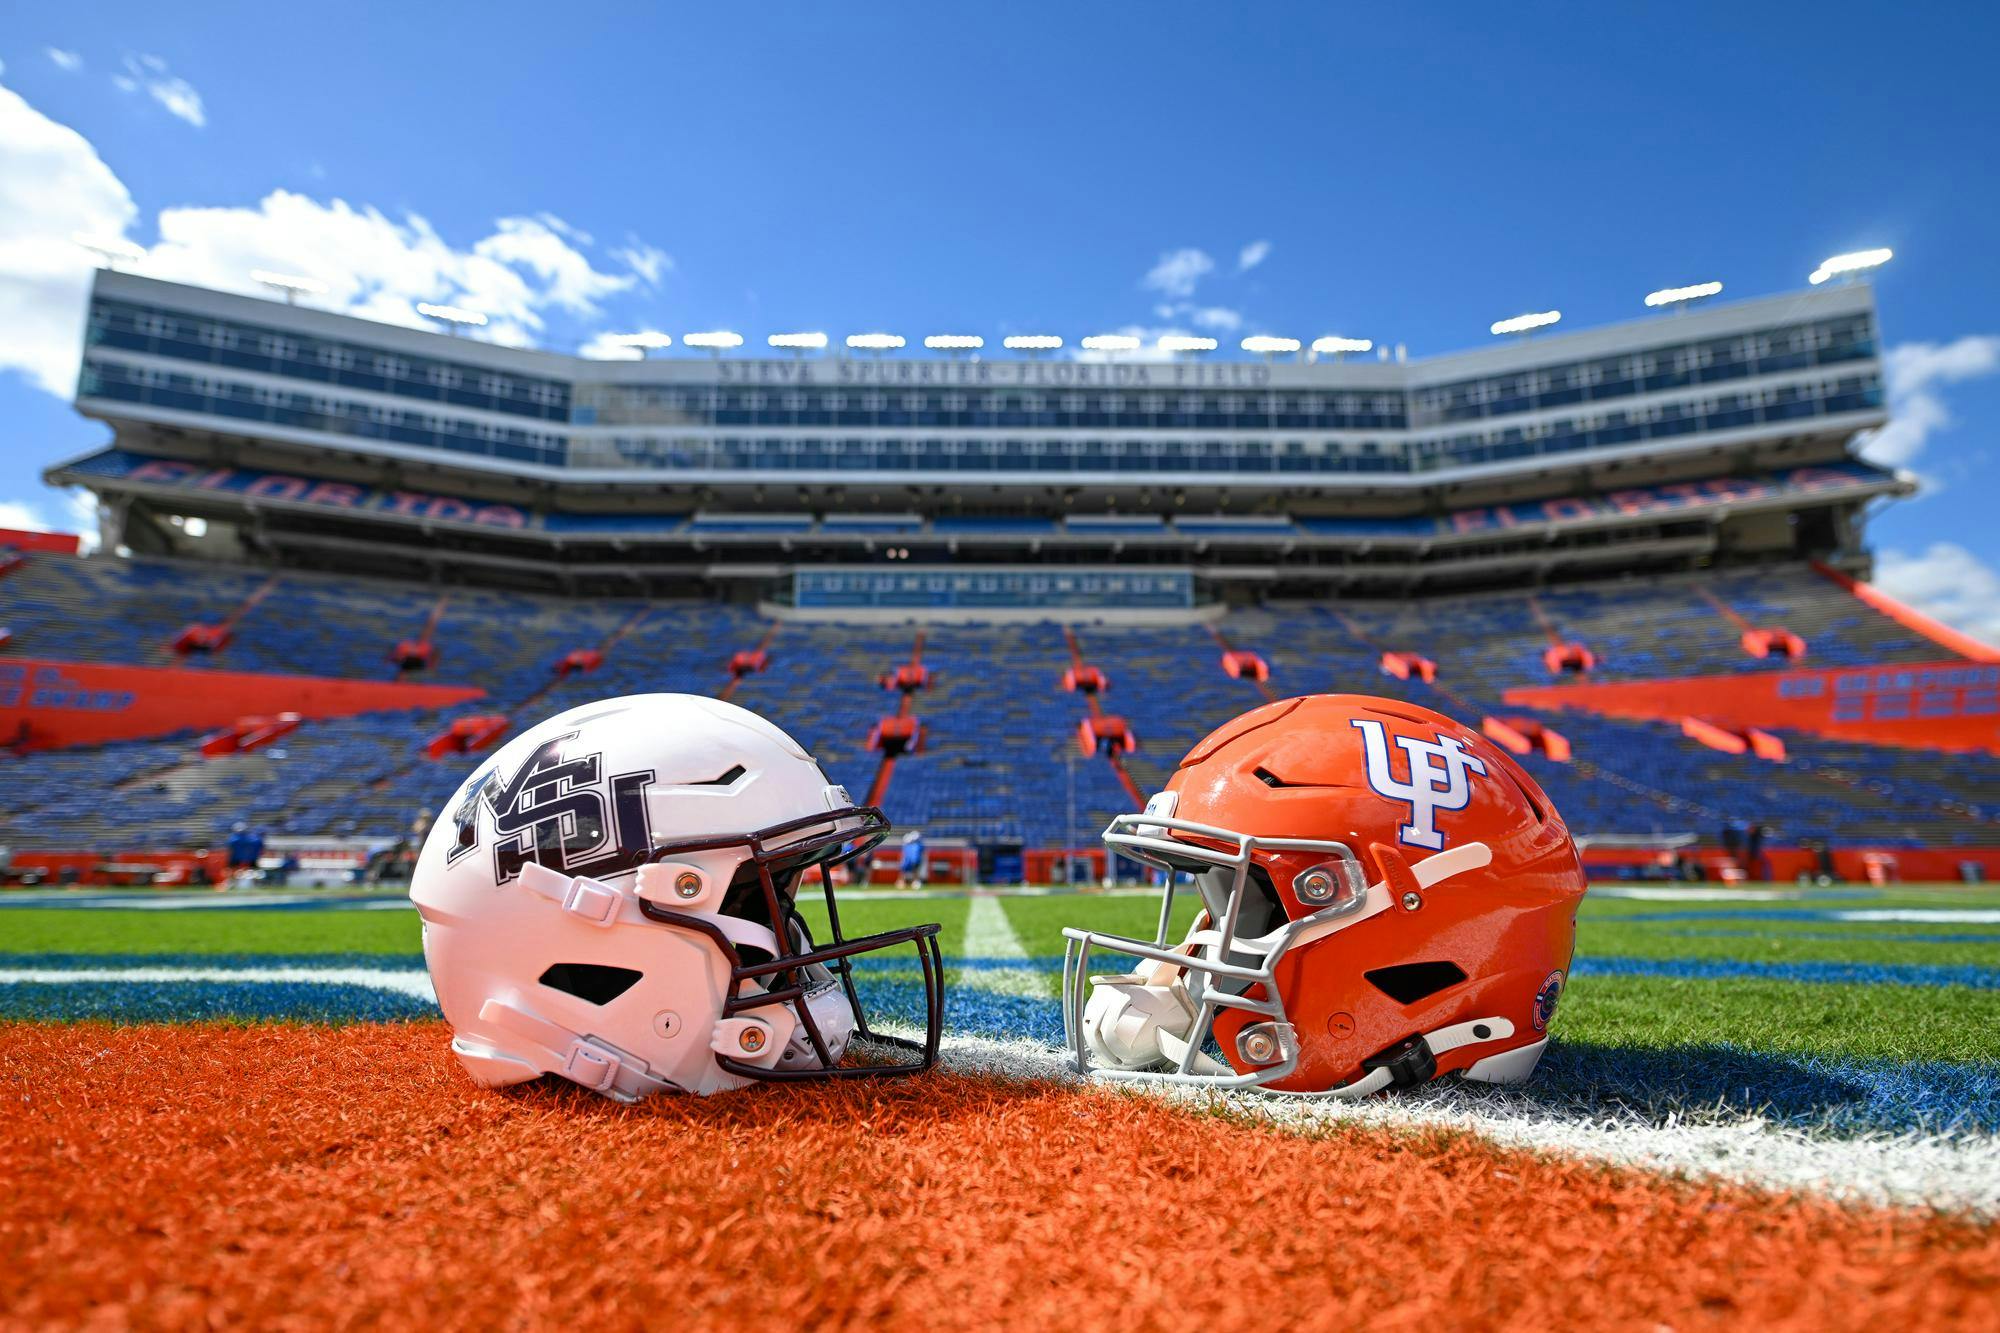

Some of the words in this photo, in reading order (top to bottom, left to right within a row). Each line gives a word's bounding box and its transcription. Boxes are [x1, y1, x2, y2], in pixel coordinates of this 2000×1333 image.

[718, 362, 811, 385] STEVE
[1175, 364, 1271, 387] FIELD
[127, 460, 524, 529] FLORIDA
[1349, 719, 1488, 853] UF
